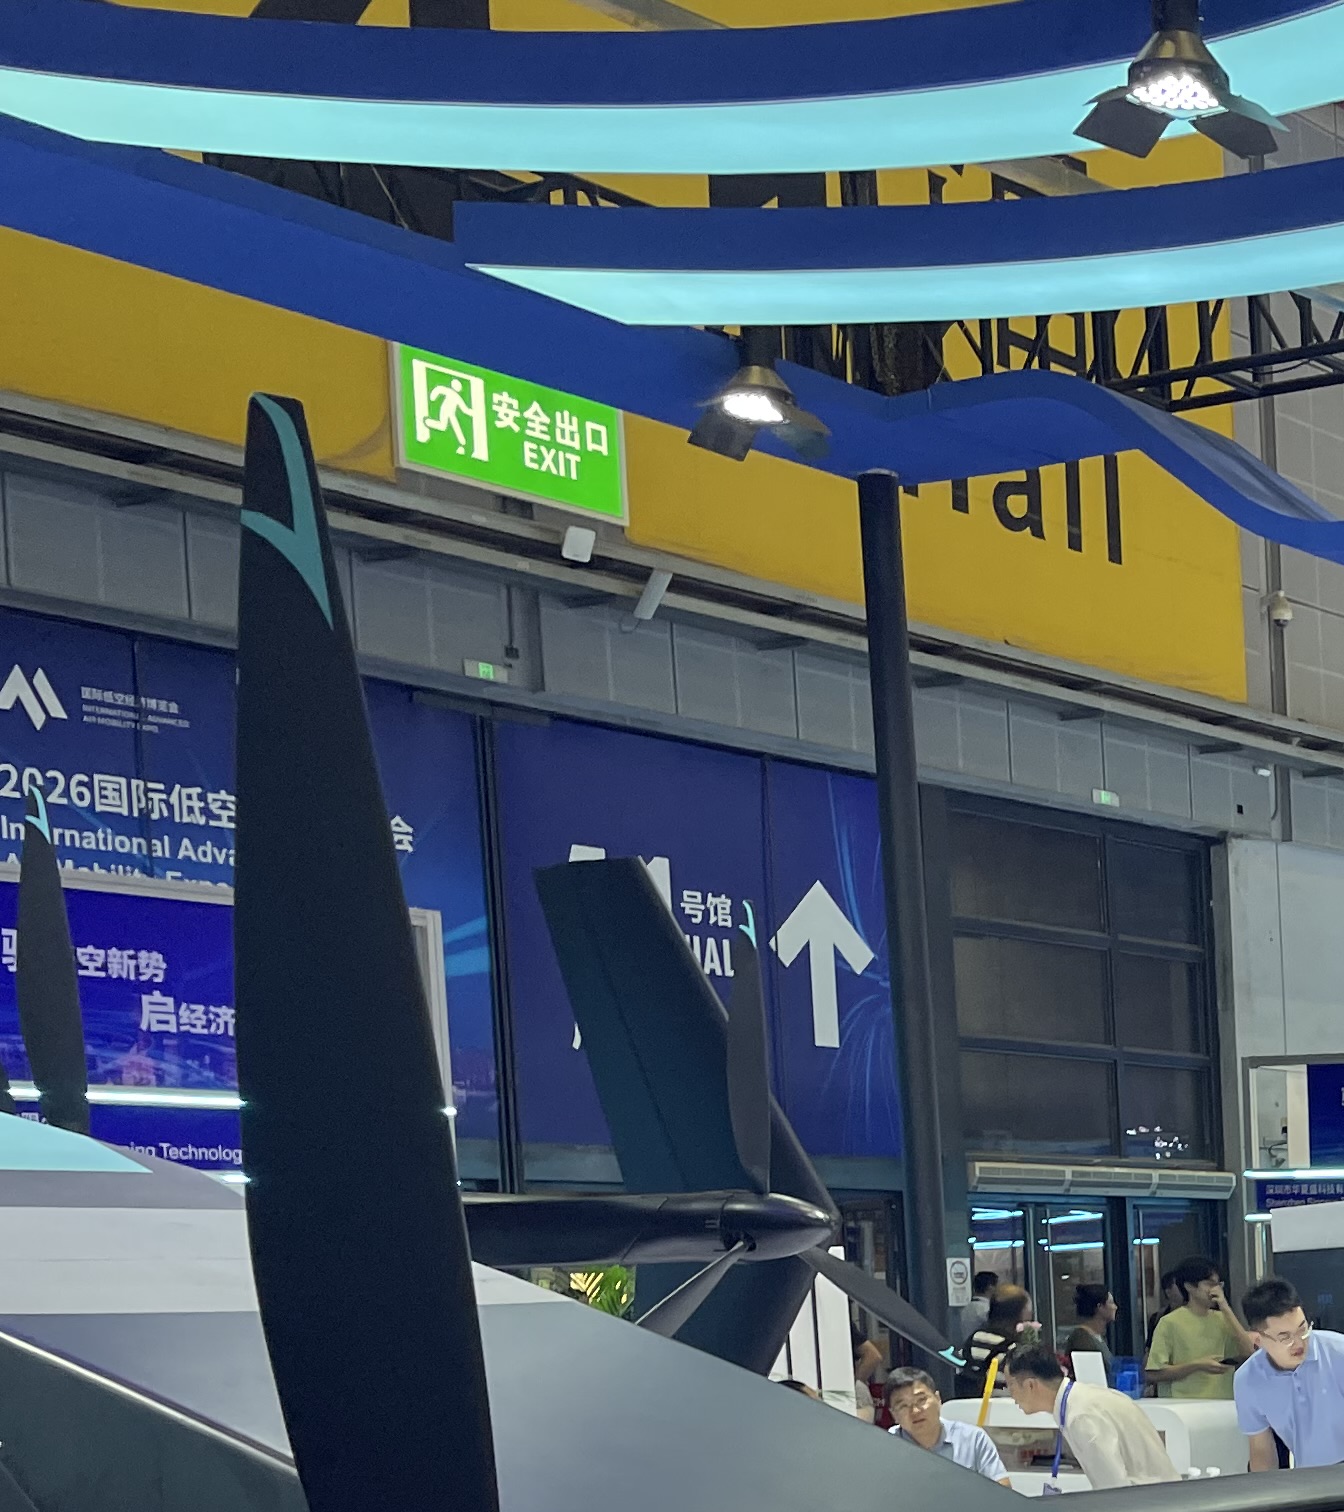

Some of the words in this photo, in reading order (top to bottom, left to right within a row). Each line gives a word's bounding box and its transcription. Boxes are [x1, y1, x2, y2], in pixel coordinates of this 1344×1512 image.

[492, 391, 608, 456] 安全出口
[524, 441, 581, 480] EXIT
[903, 454, 1122, 565] all
[1, 815, 170, 858] Inrnational
[140, 990, 236, 1037] 启经济
[159, 1143, 242, 1165] Technolog
